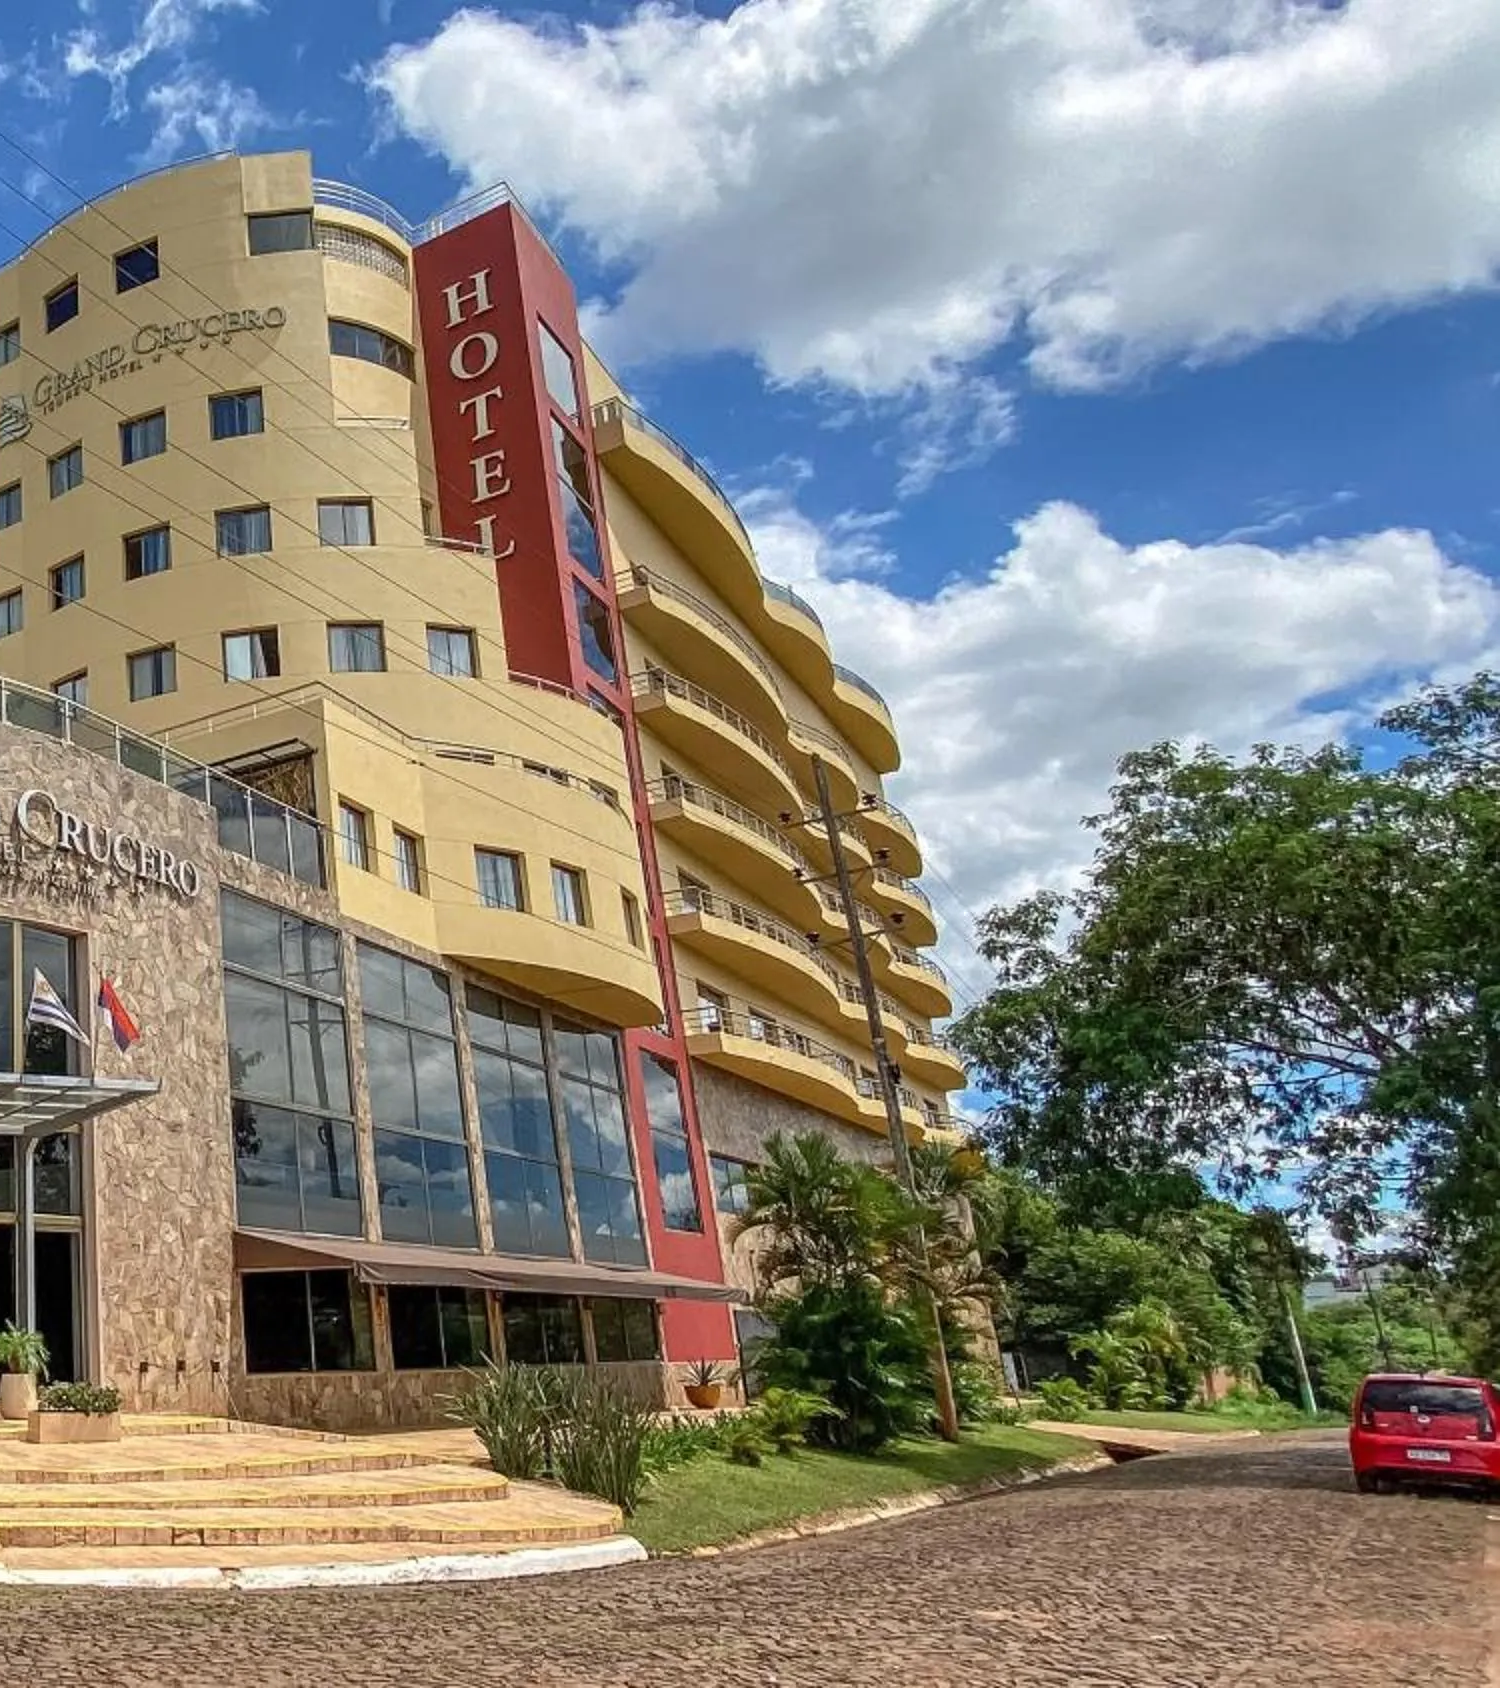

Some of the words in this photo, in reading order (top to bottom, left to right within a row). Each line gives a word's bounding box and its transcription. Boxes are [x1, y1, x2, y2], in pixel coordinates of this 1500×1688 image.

[33, 345, 125, 407] GRAND
[132, 306, 287, 355] CRUCERO
[99, 361, 143, 384] HOTEL
[442, 267, 516, 560] HOTEL
[17, 789, 200, 897] CRUCERO
